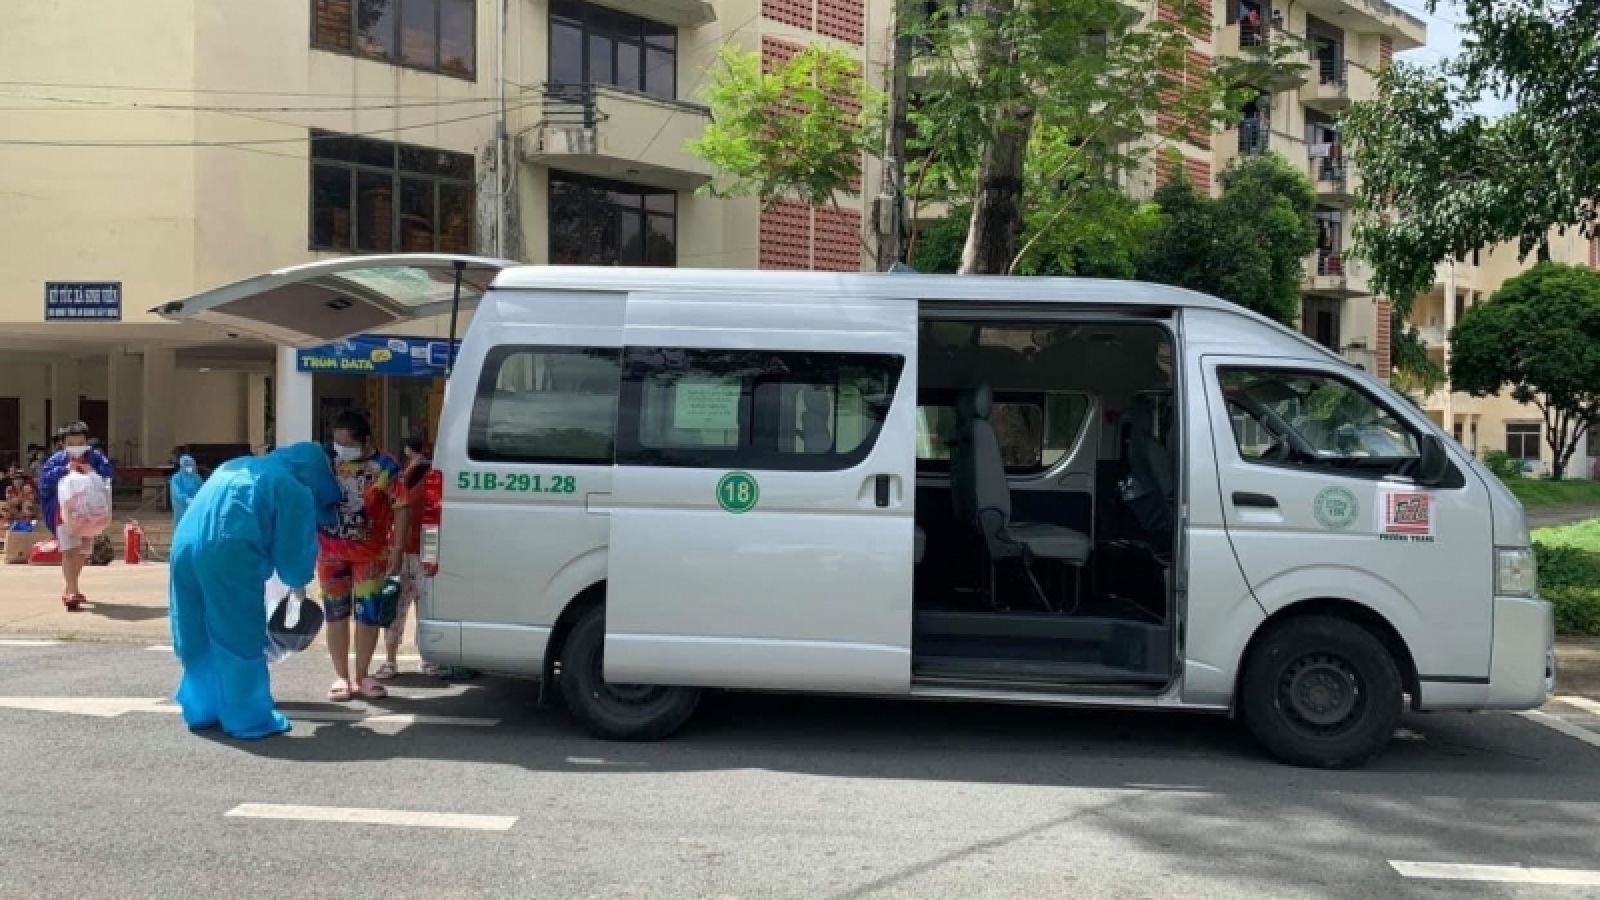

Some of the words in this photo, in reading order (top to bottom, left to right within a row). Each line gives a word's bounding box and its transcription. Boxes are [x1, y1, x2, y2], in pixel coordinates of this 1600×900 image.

[340, 358, 375, 370] DATA
[458, 472, 577, 494] 51B-291.28
[725, 482, 750, 503] 18
